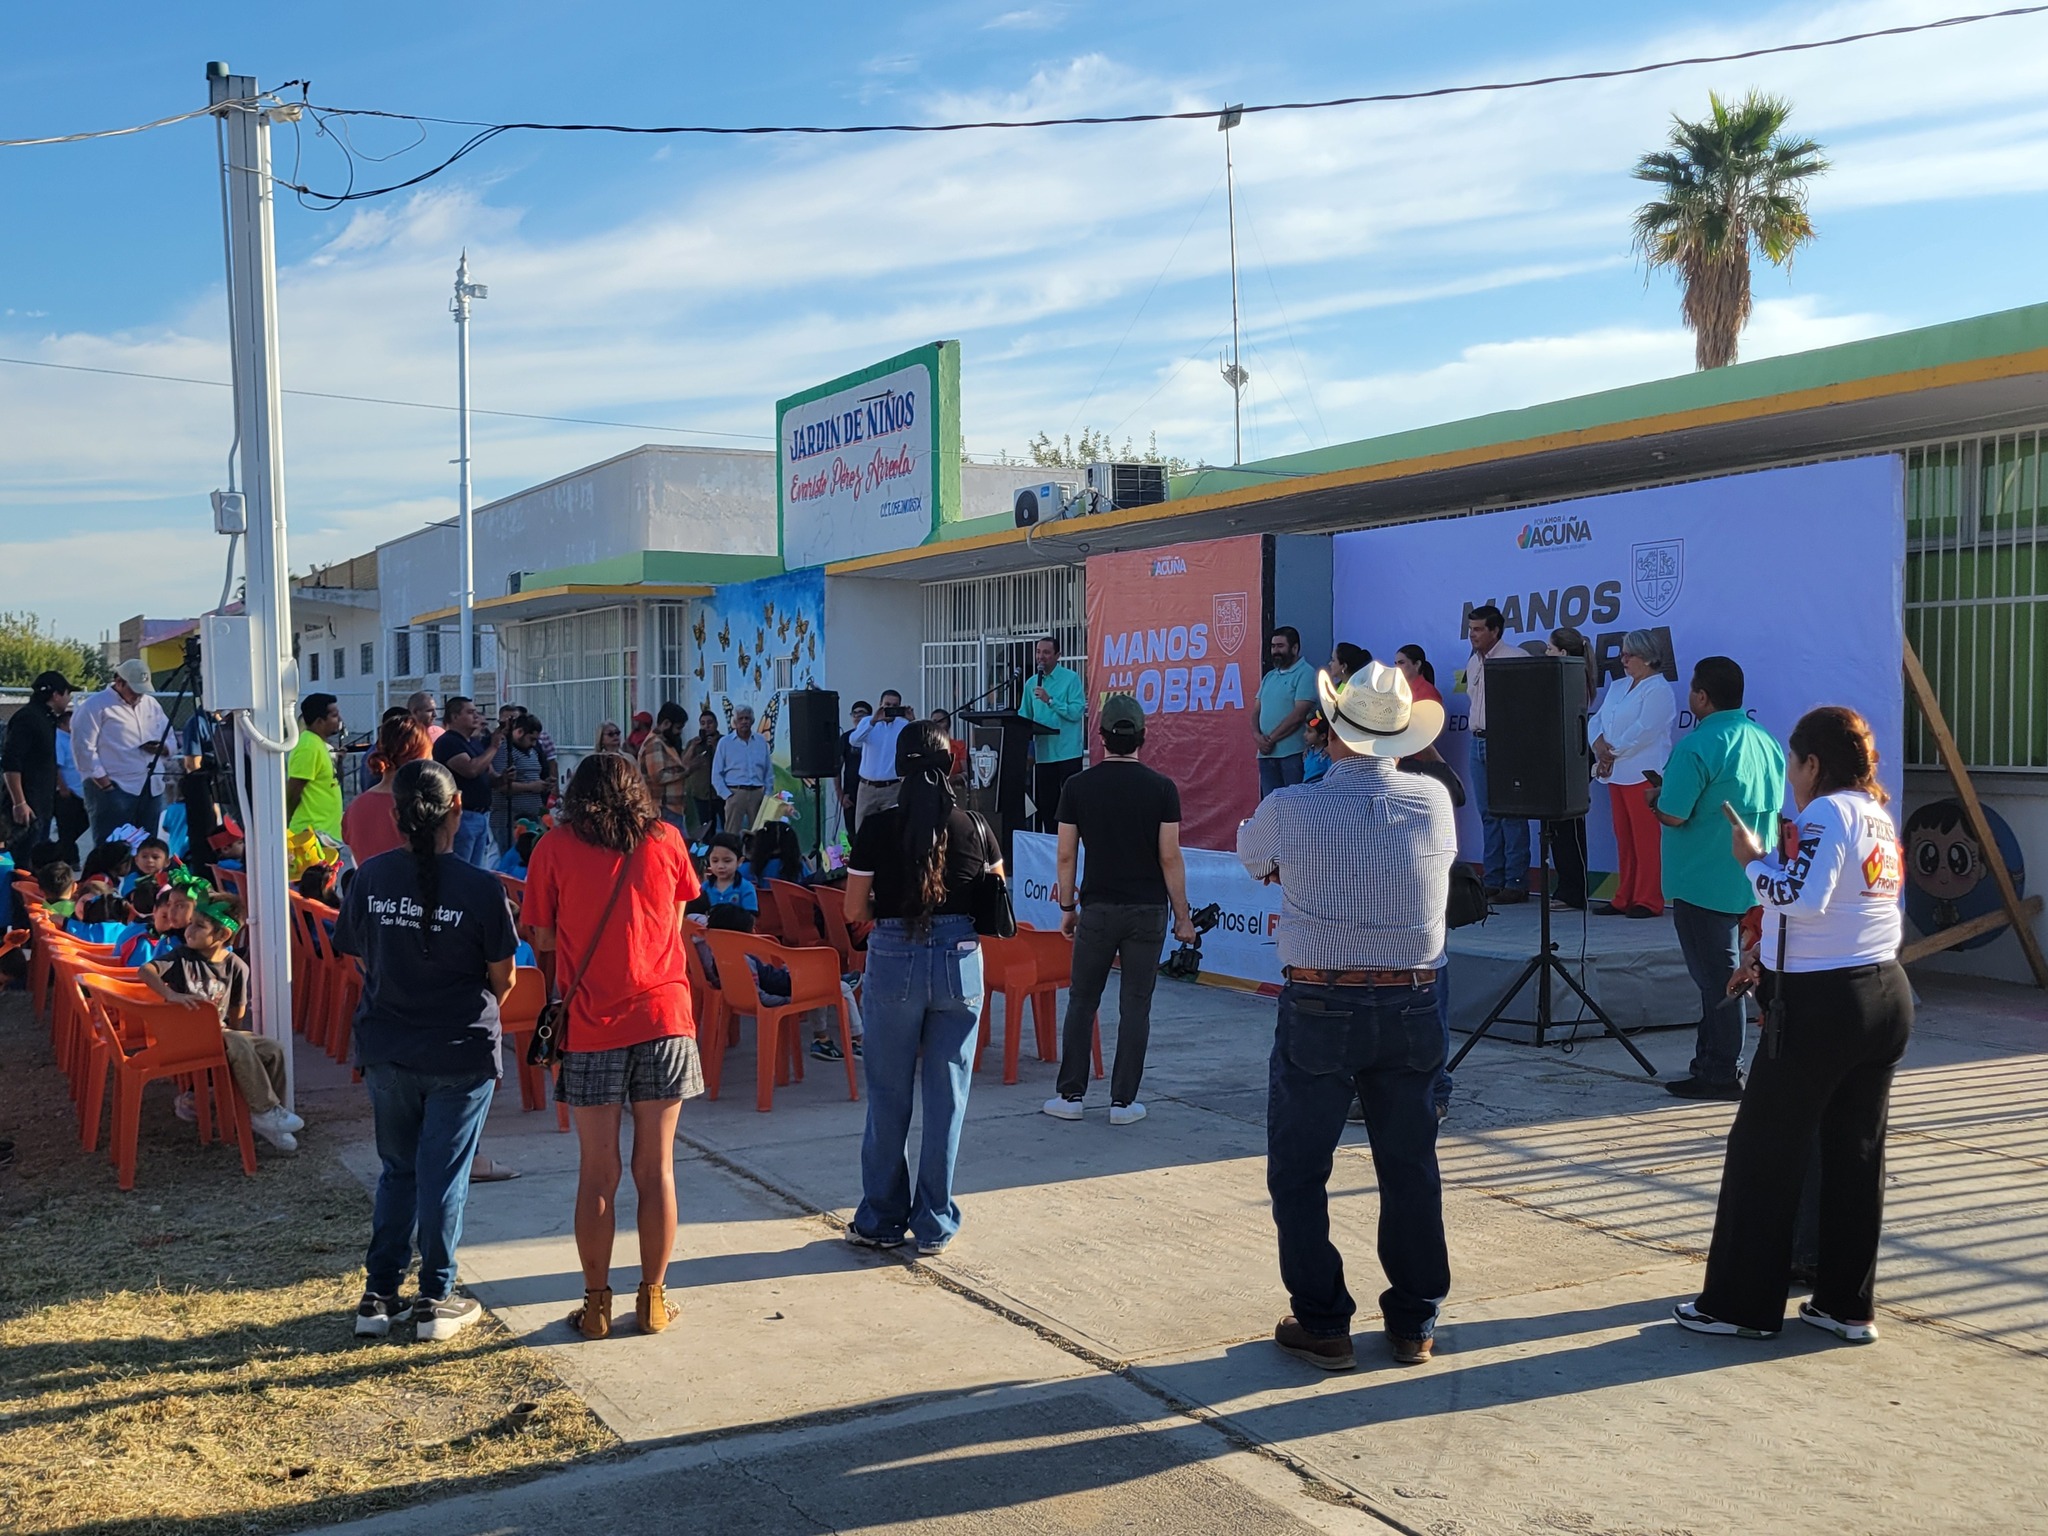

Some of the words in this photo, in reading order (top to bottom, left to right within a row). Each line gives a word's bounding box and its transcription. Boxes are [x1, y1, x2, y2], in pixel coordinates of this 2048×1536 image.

[790, 414, 841, 461] JARDIN
[843, 407, 864, 445] DE
[866, 389, 916, 439] NIÑOS
[865, 443, 916, 490] Arreola
[1529, 516, 1592, 548] ACUÑA
[1155, 556, 1187, 576] ACUÑA
[1103, 623, 1208, 668] MANOS
[1108, 672, 1117, 688] A
[1119, 671, 1133, 687] LA
[1136, 662, 1245, 715] OBRA
[1024, 878, 1048, 901] Con
[1877, 877, 1898, 891] FRONT
[368, 895, 397, 914] Travis
[380, 914, 394, 926] San
[1248, 911, 1263, 936] el
